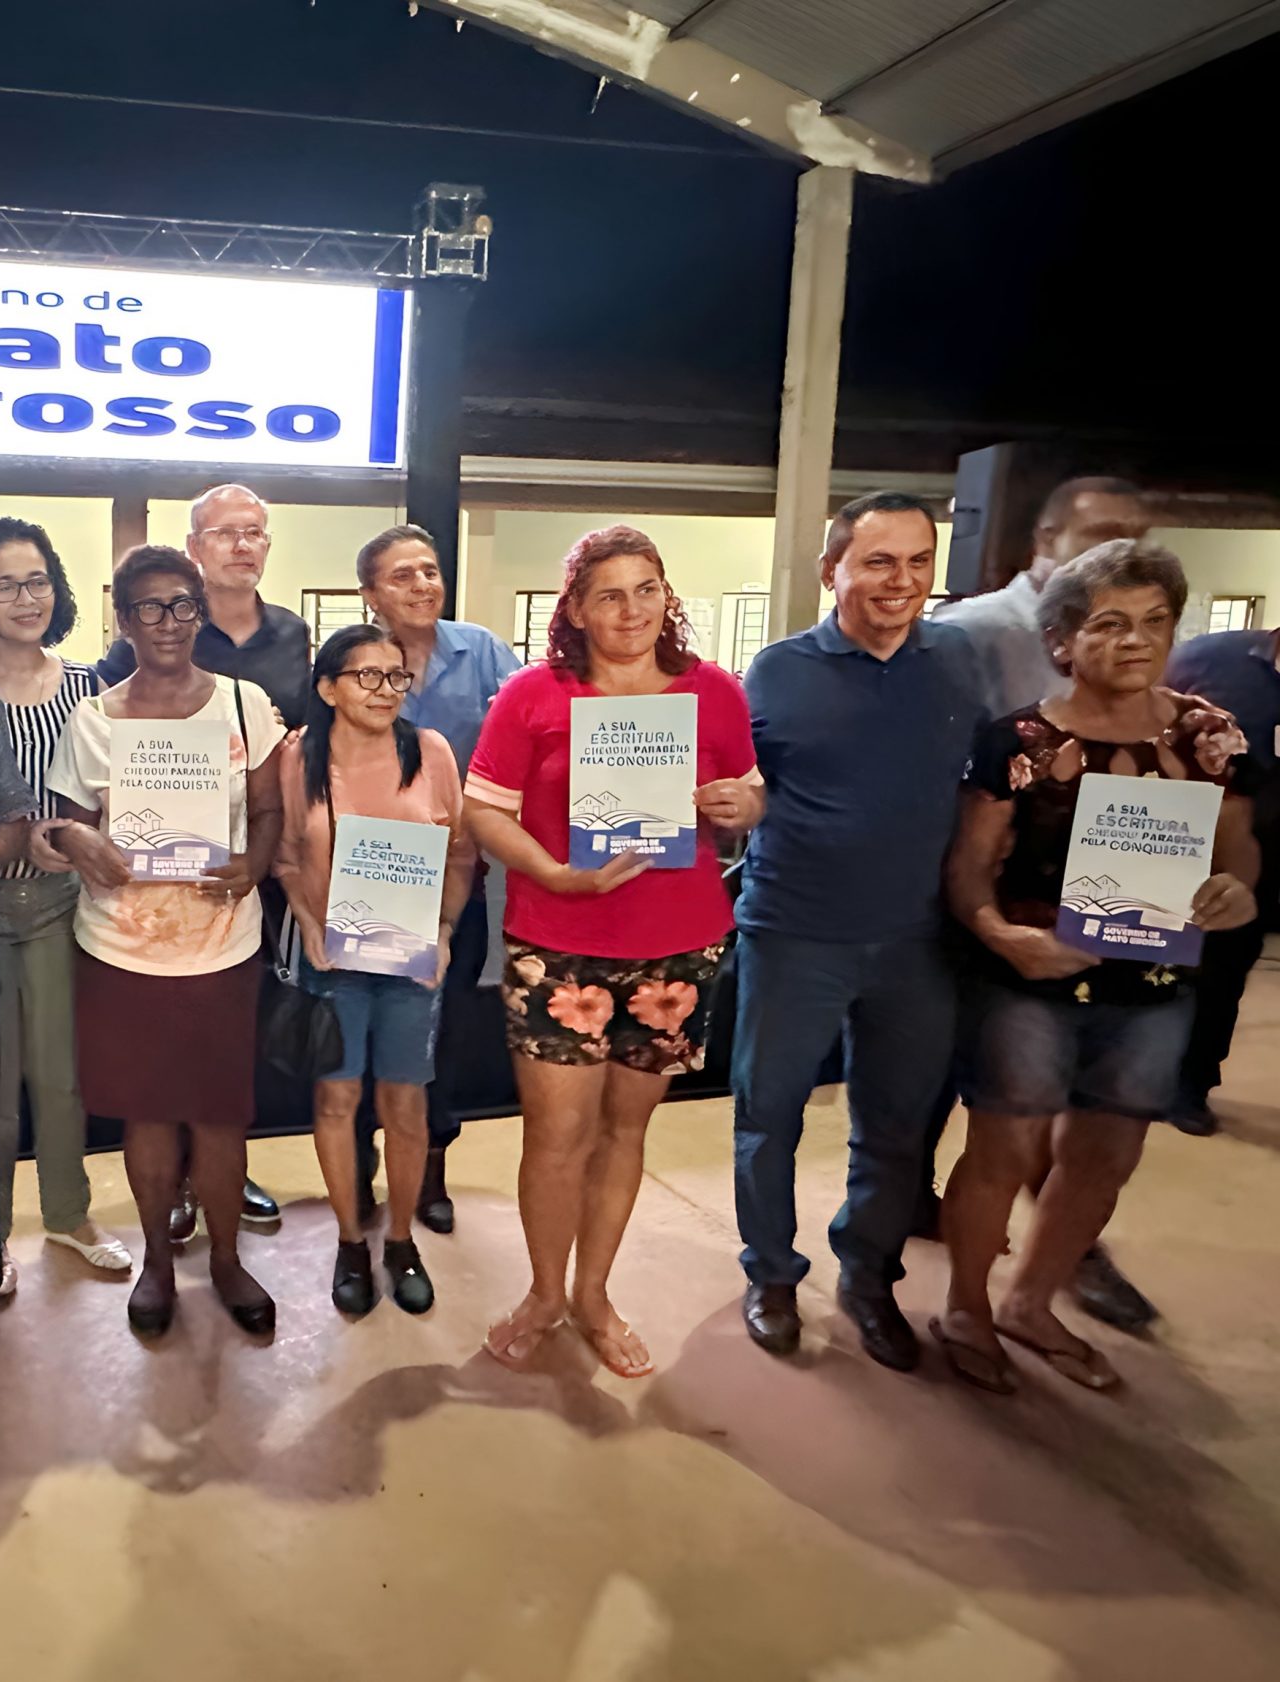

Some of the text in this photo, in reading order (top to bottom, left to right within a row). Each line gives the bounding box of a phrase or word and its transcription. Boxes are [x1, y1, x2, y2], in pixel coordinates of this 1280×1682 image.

[83, 290, 143, 313] de
[598, 721, 636, 731] A SUA
[590, 731, 675, 744] ESCRITURA
[137, 740, 173, 750] A SUA
[130, 752, 210, 764] ESCRITURA
[606, 755, 688, 767] CONQUISTA.
[1106, 803, 1148, 816] A SUA
[1095, 814, 1190, 833] ESCRITURA
[359, 839, 366, 847] A
[1102, 935, 1129, 944] MATO
